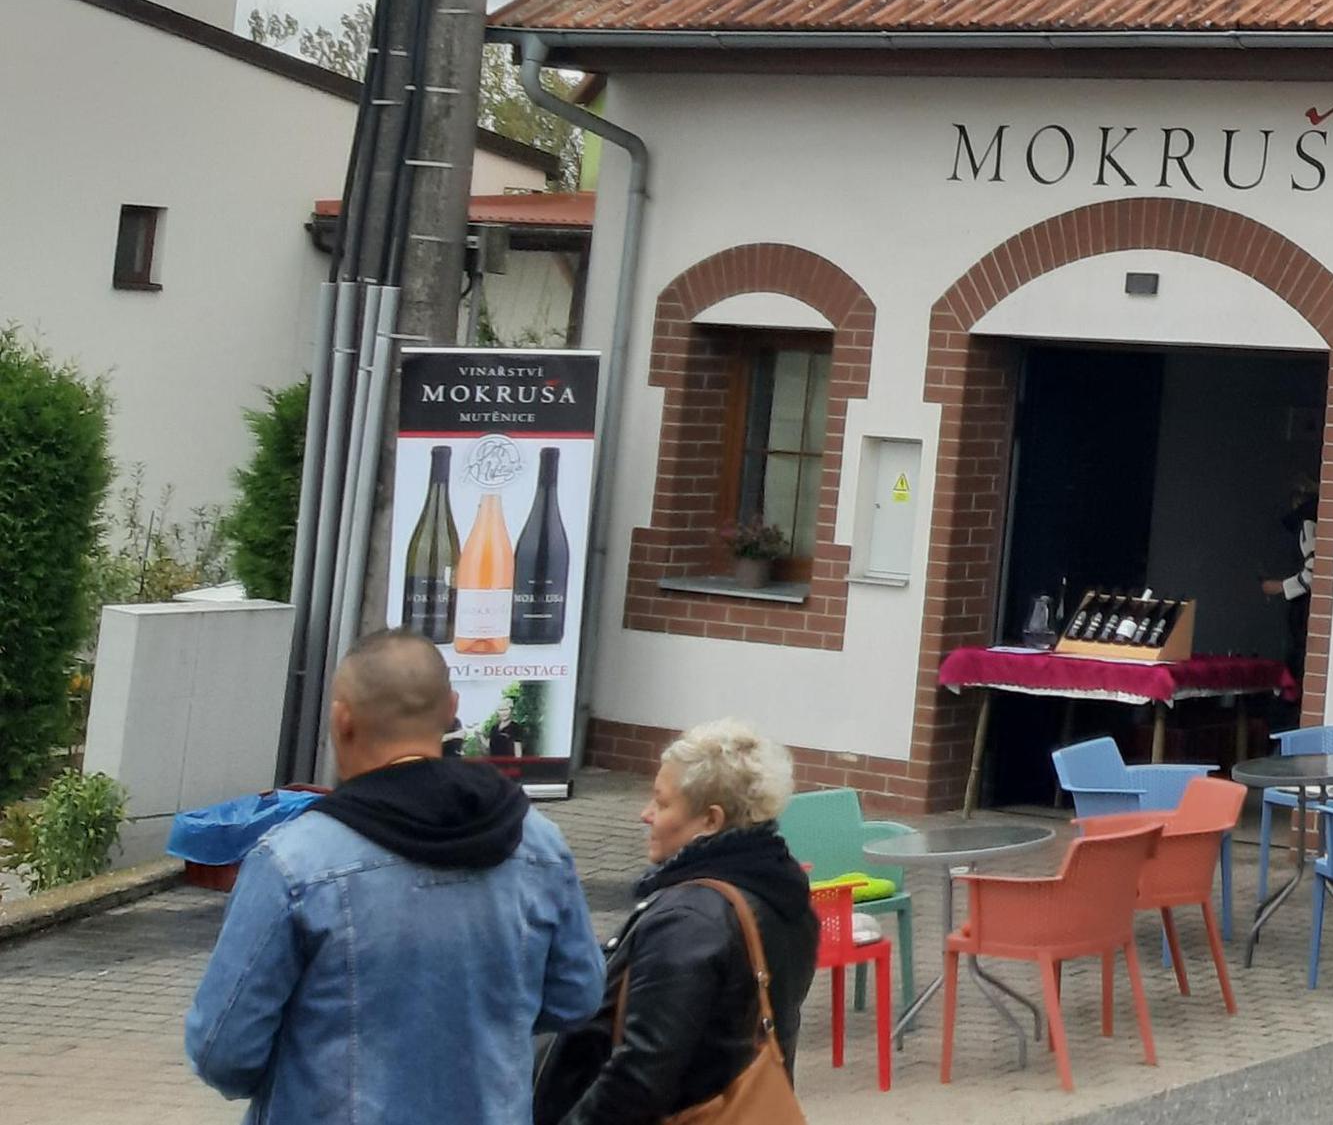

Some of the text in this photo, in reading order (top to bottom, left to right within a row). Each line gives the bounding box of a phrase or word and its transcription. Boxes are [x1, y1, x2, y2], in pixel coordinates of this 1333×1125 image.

[458, 365, 544, 377] VINAŘSTVÍ
[421, 379, 576, 404] MOKRUŠA
[459, 411, 536, 423] MUTĚNICE
[483, 665, 568, 677] DEGUSTACE
